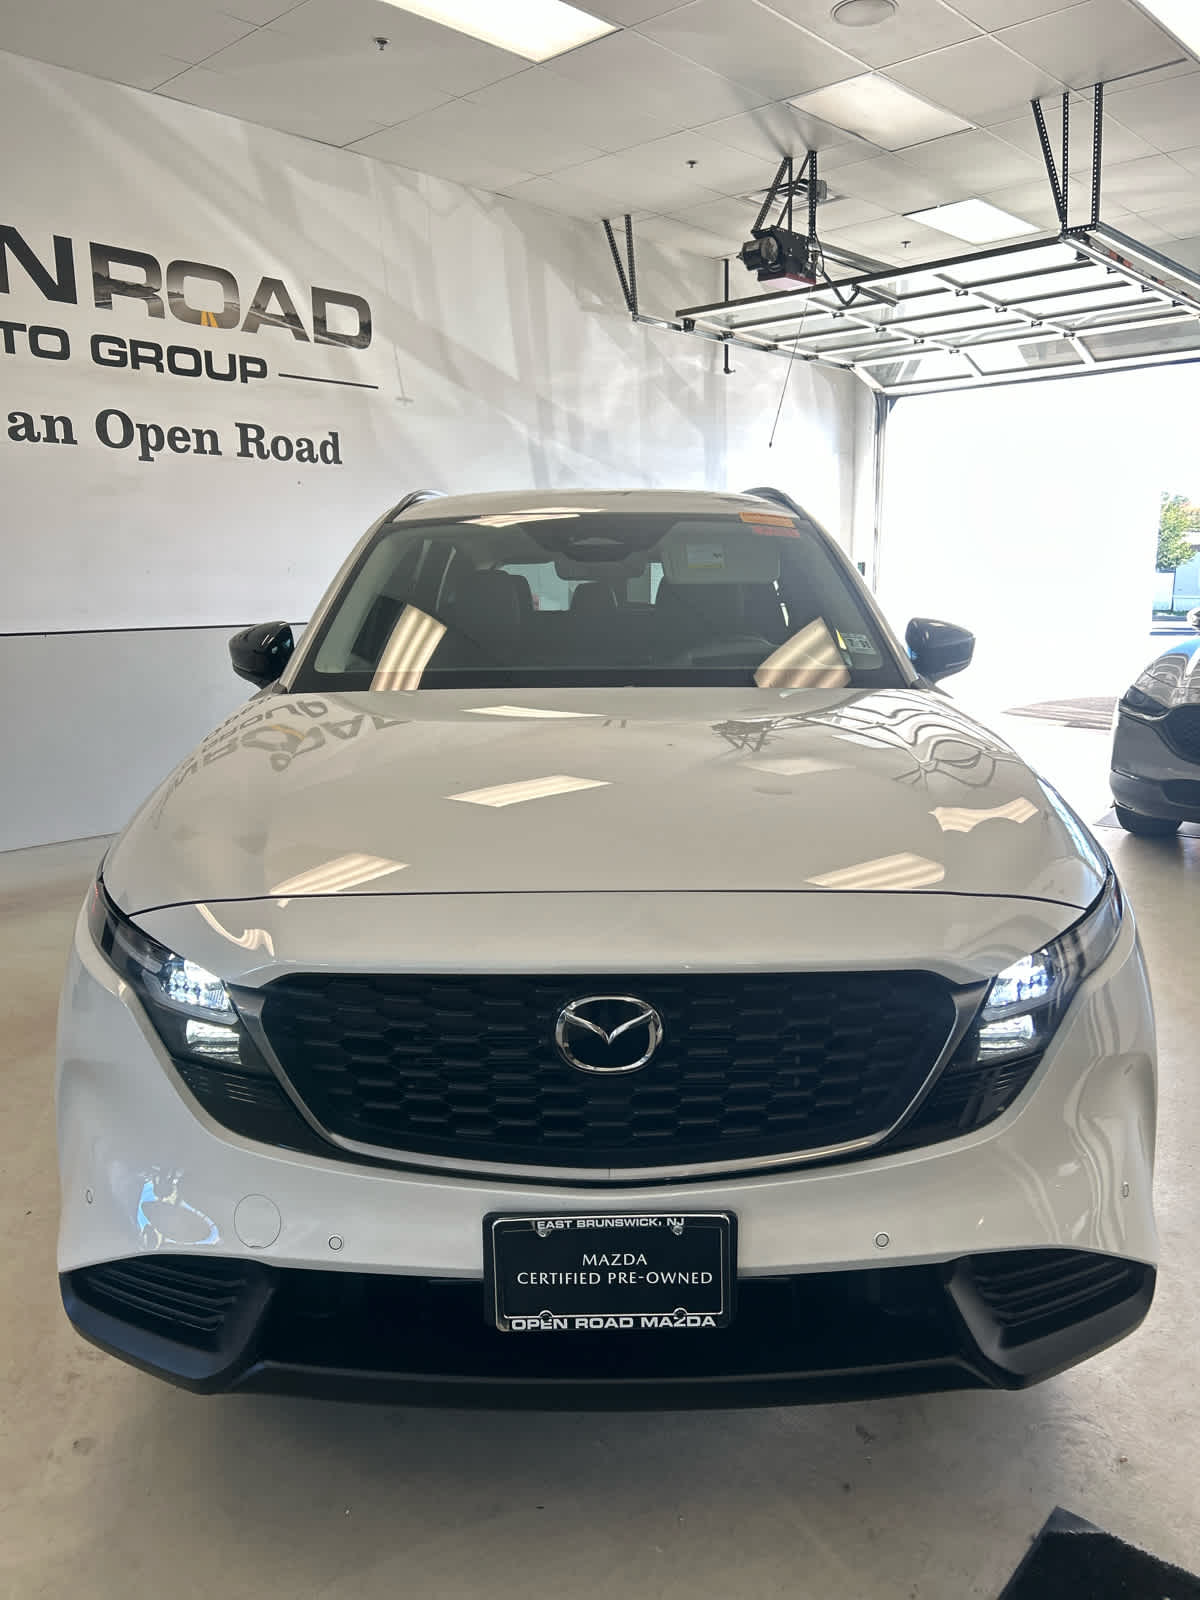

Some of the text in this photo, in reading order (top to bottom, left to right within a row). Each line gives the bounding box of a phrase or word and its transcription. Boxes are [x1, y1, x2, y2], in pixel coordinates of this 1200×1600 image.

[90, 334, 268, 384] GROUP
[7, 408, 343, 465] an Open Road
[537, 1217, 685, 1230] EAST BRUNSWICK, NJ
[582, 1253, 648, 1266] MAZDA
[517, 1271, 713, 1285] CERTIFIED PRE-OWNED
[511, 1315, 716, 1331] OPEN ROAD MAZDA
